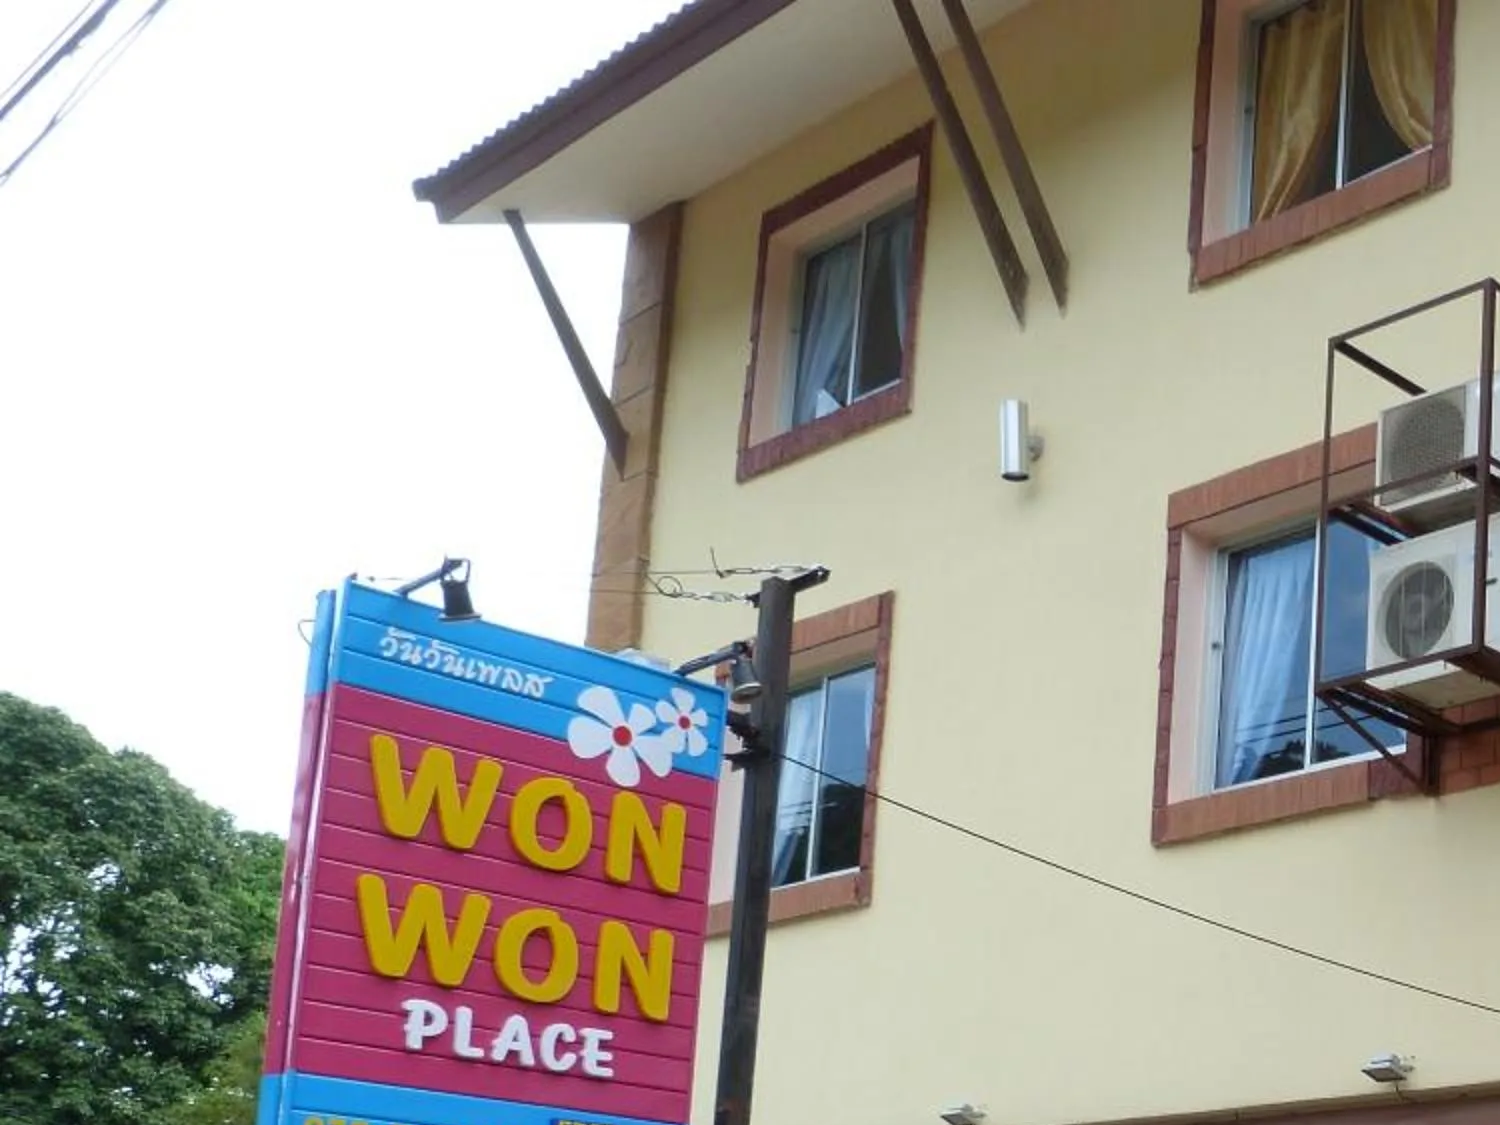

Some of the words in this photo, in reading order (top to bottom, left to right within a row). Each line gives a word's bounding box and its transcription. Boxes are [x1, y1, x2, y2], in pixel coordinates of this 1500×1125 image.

[369, 733, 688, 896] WON
[355, 872, 675, 1023] WON
[400, 997, 615, 1079] PLACE
